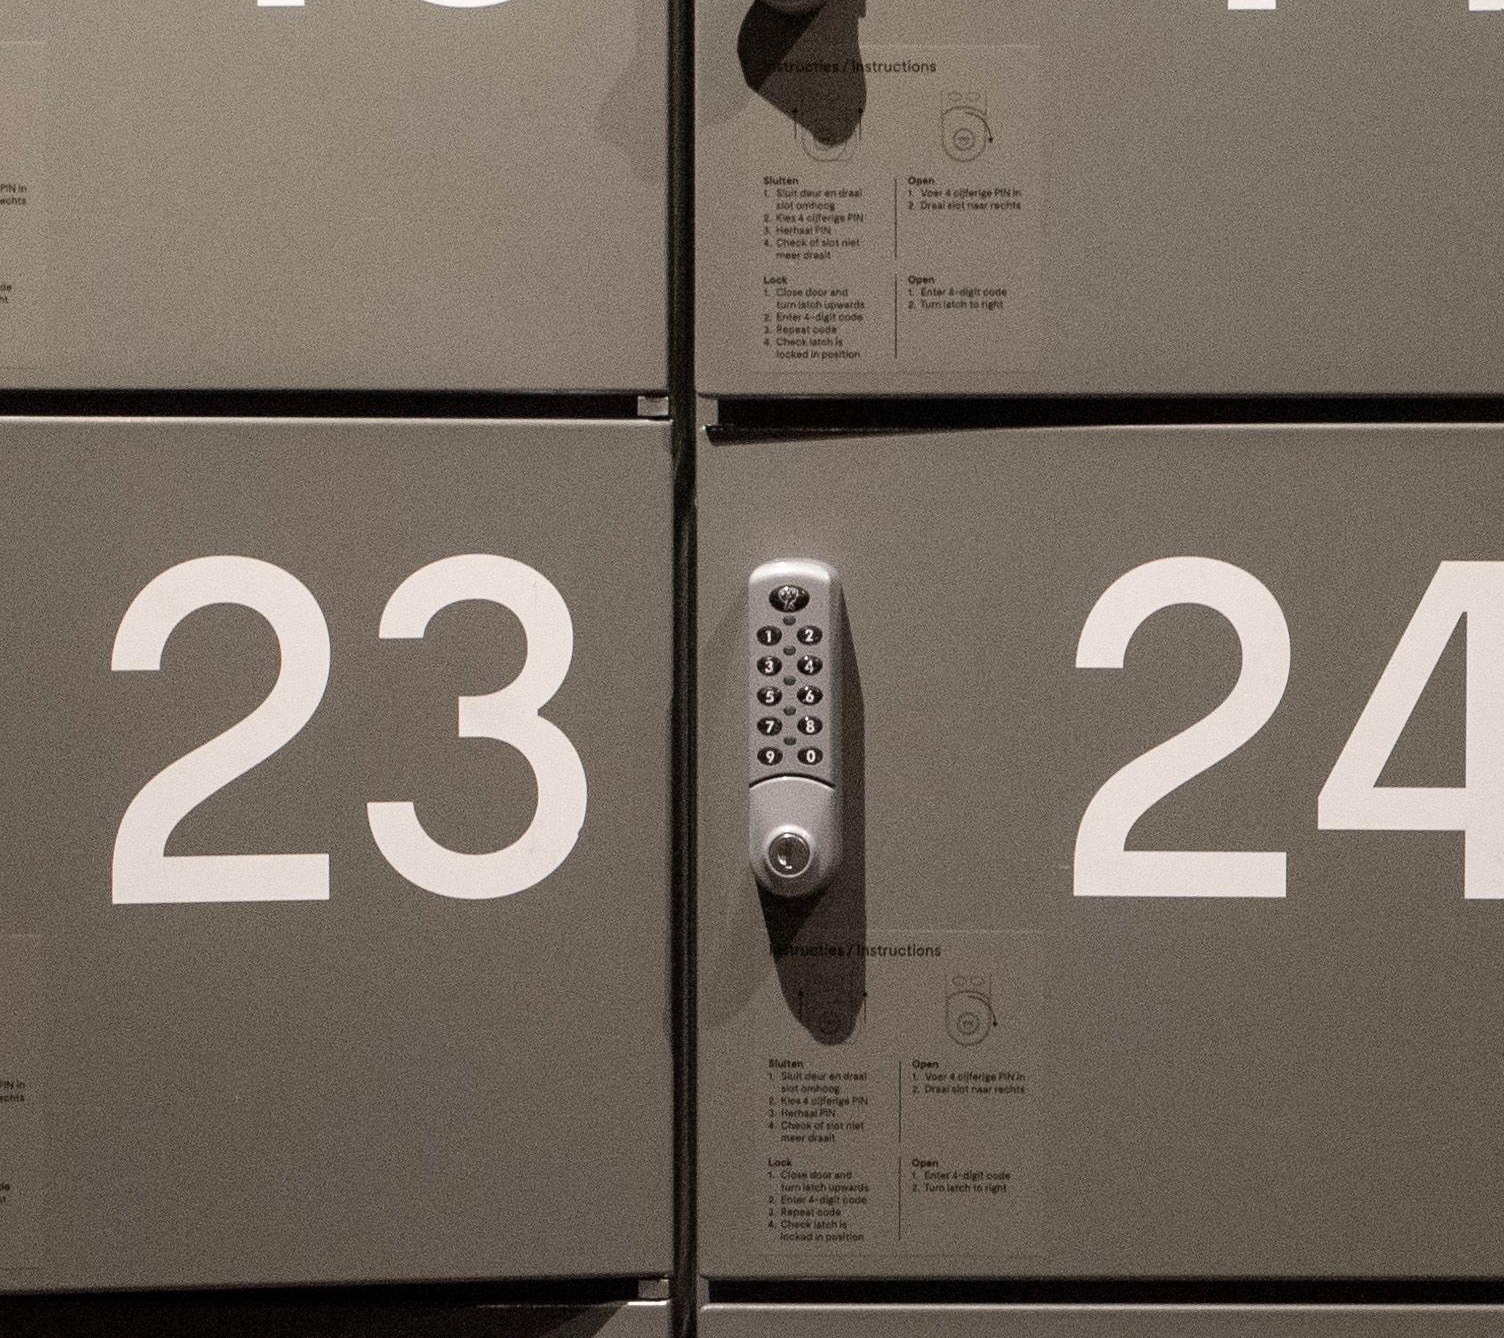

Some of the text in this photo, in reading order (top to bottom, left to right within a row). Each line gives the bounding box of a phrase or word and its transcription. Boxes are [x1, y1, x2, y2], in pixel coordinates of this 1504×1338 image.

[852, 60, 937, 72] Instructions
[908, 176, 935, 186] Open
[763, 276, 787, 284] Lock
[908, 275, 935, 285] Open
[822, 350, 860, 360] position
[109, 552, 590, 906] 23
[857, 944, 942, 957] Instructions
